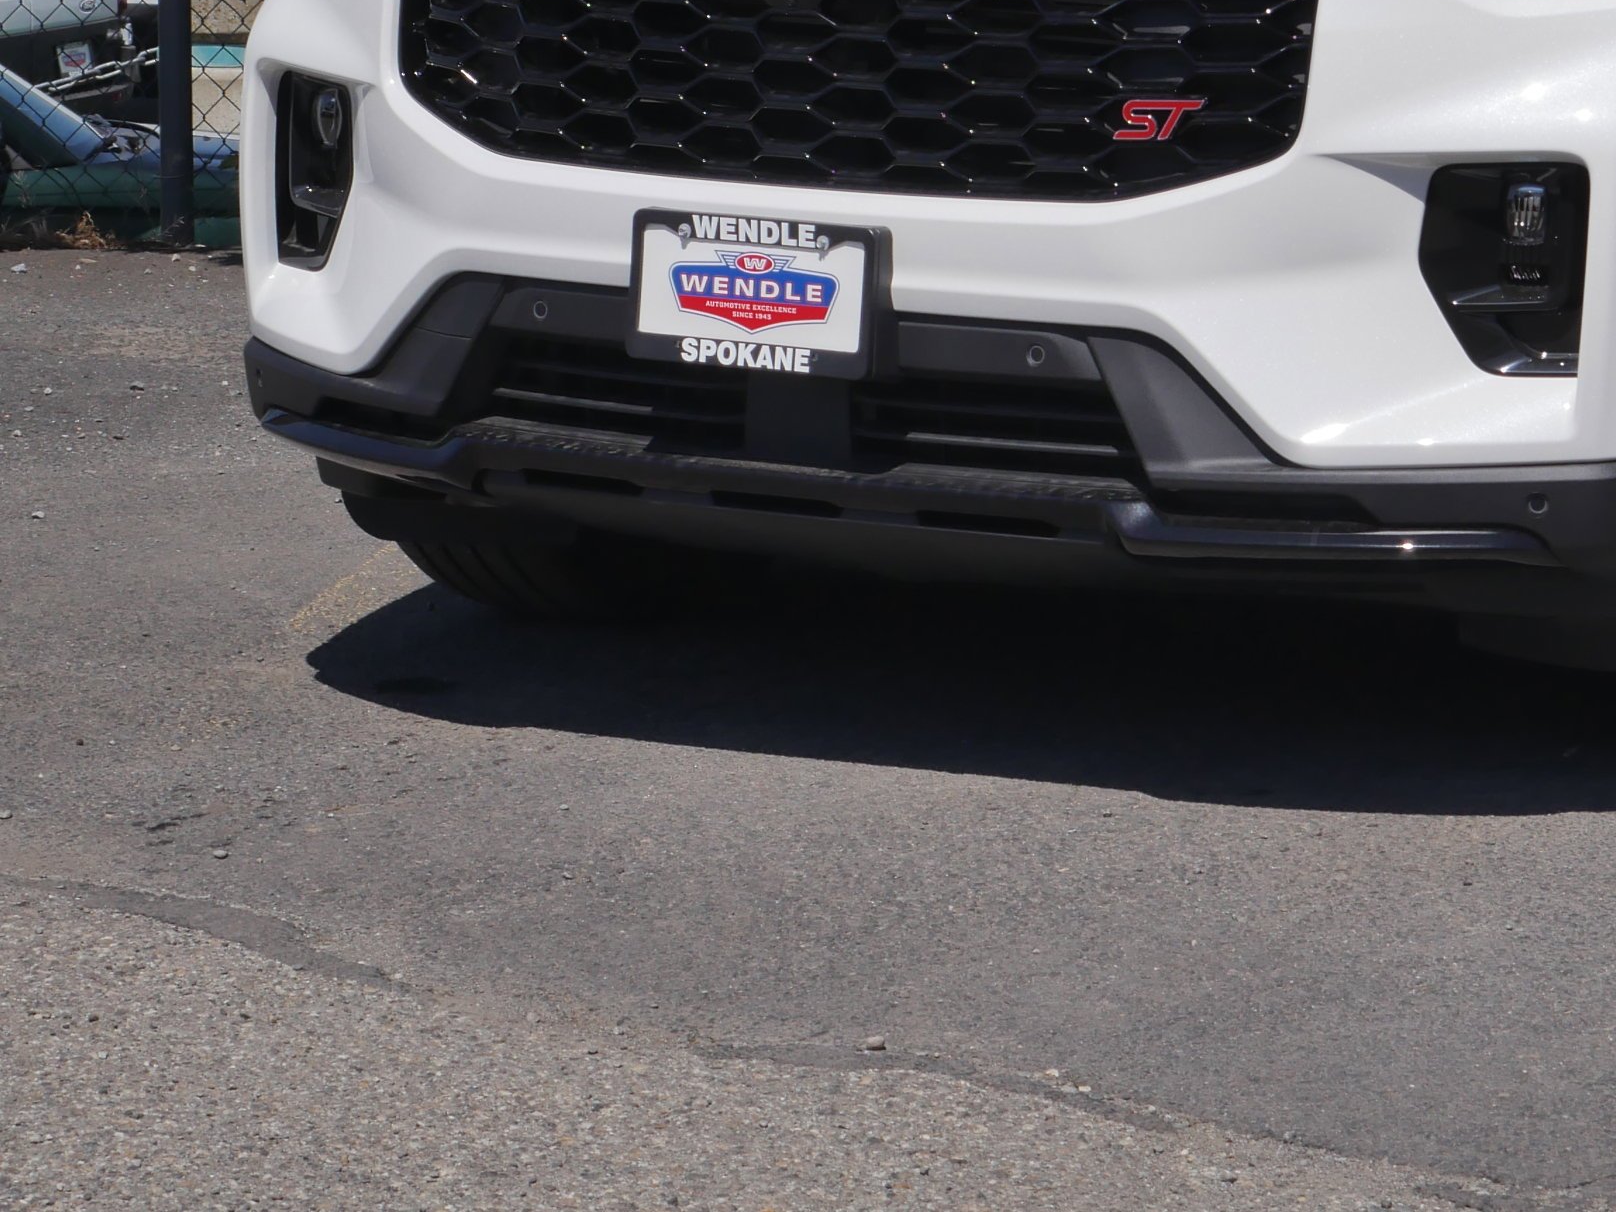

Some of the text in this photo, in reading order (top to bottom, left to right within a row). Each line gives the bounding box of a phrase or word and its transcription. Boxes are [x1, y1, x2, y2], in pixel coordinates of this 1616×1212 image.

[1112, 99, 1206, 140] ST
[691, 214, 817, 249] WENDLE
[743, 256, 767, 271] W
[680, 273, 823, 303] WENDLE
[705, 300, 797, 314] AUTOMOTIVE EXCELLENCE
[732, 310, 753, 319] SINCE
[680, 337, 812, 374] SPOKANE
